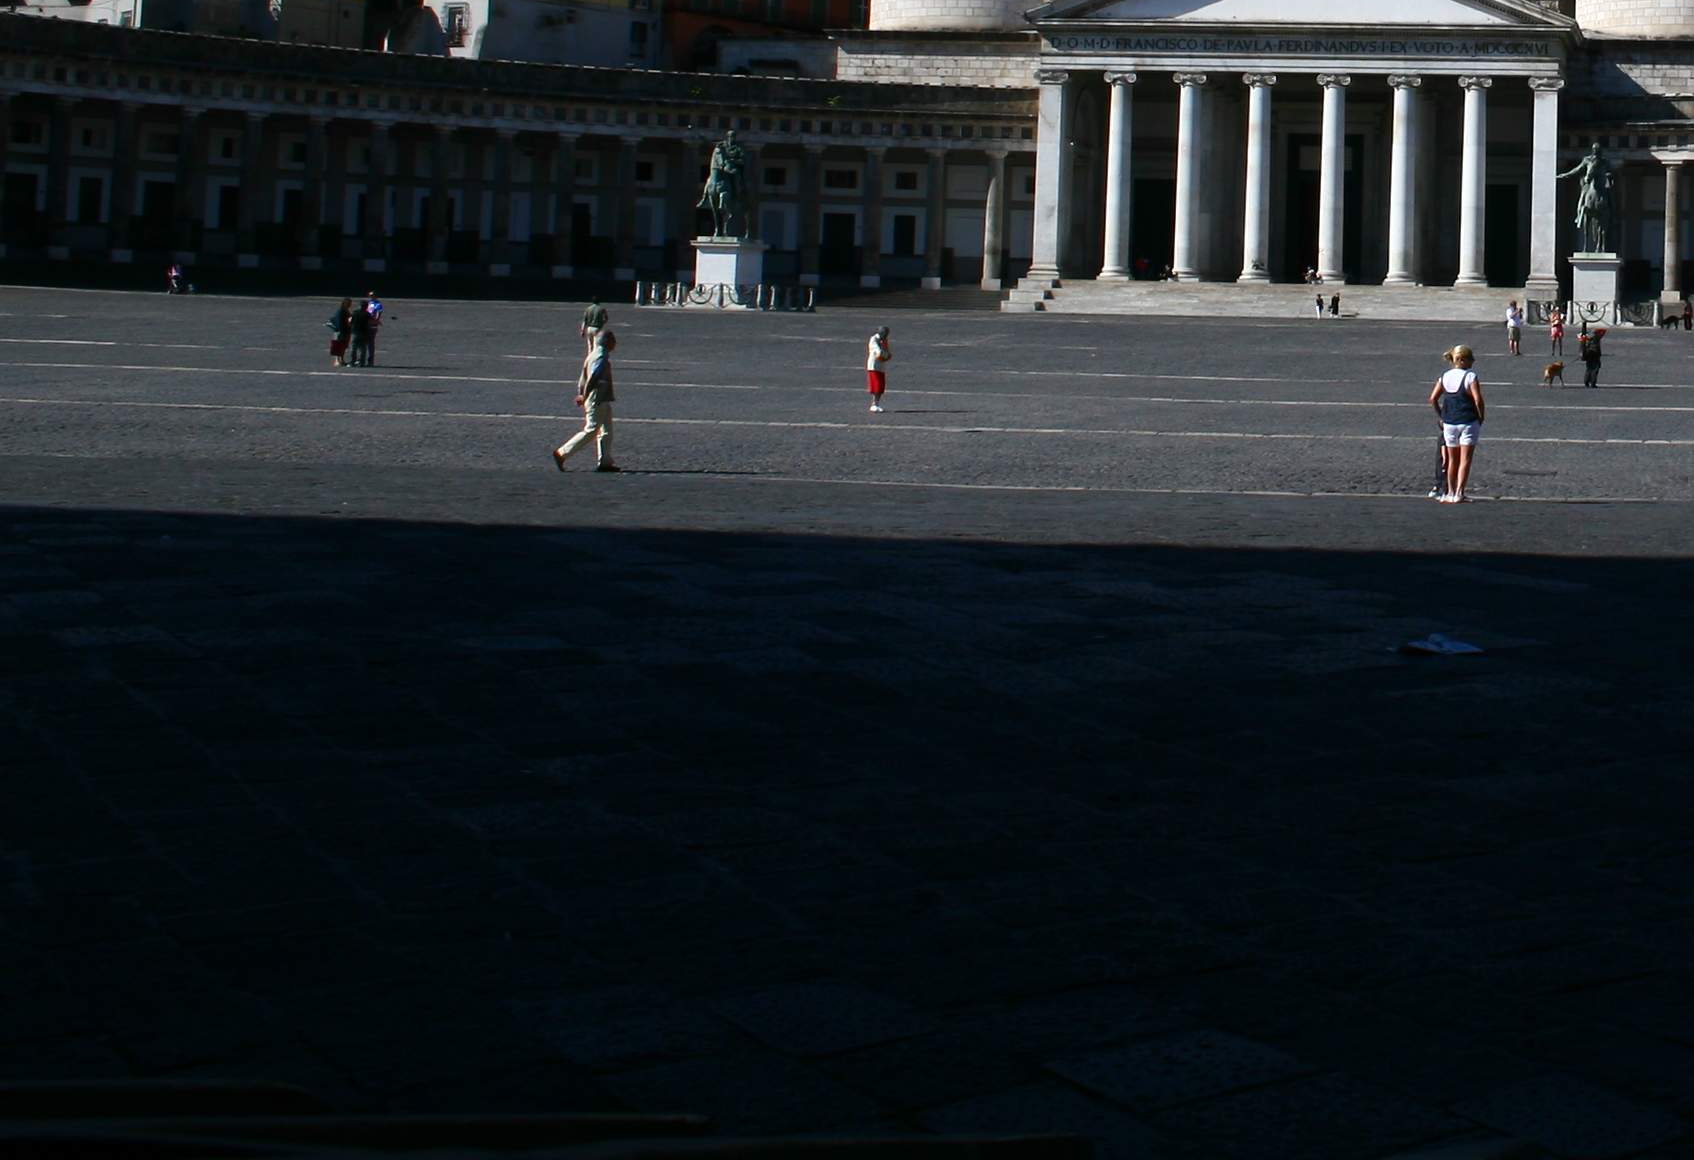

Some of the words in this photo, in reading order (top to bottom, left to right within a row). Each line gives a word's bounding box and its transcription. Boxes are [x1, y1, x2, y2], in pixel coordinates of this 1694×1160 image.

[1115, 38, 1198, 50] FRANCISCO
[1203, 39, 1221, 51] DE
[1278, 40, 1377, 53] FERDINANDVS
[1413, 41, 1455, 54] VOTO
